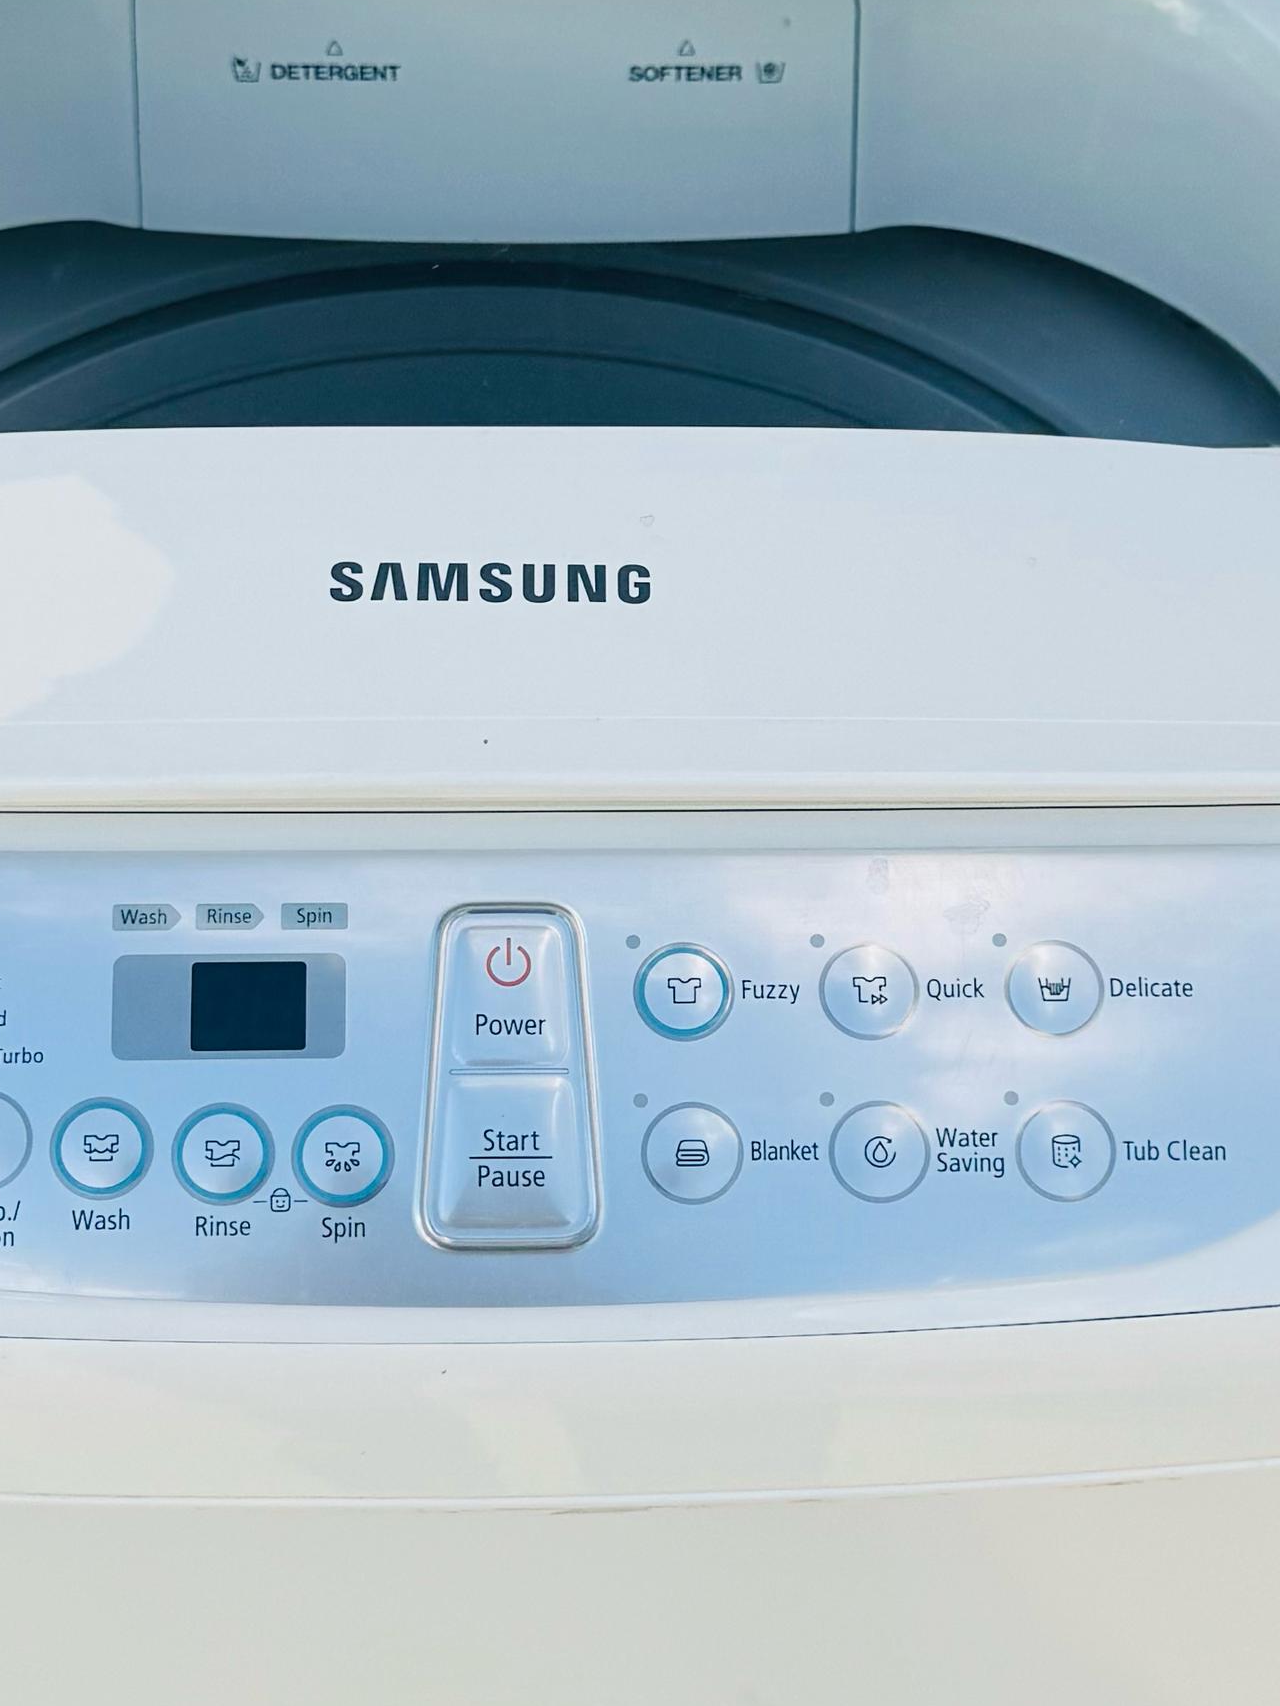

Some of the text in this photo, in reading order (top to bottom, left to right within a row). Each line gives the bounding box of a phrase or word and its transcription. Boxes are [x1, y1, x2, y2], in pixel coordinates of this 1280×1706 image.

[270, 63, 401, 82] DETERGENT
[629, 65, 742, 82] SOFTENER
[329, 561, 651, 605] SAMSUNG
[120, 908, 167, 925] Wash
[207, 908, 252, 924] Rinse
[296, 907, 332, 928] Spin
[741, 979, 800, 1005] Fuzzy
[926, 977, 985, 1002] Quick
[1109, 976, 1193, 998] Delicate
[475, 1013, 546, 1036] Power
[482, 1128, 541, 1152] Start
[751, 1138, 820, 1161] Blanket
[935, 1127, 999, 1150] Water
[1122, 1139, 1227, 1161] Tub Clean
[478, 1164, 546, 1188] Pause
[936, 1151, 1005, 1179] Saving
[71, 1207, 130, 1231] Wash
[195, 1215, 251, 1237] Rinse
[321, 1216, 366, 1244] Spin
